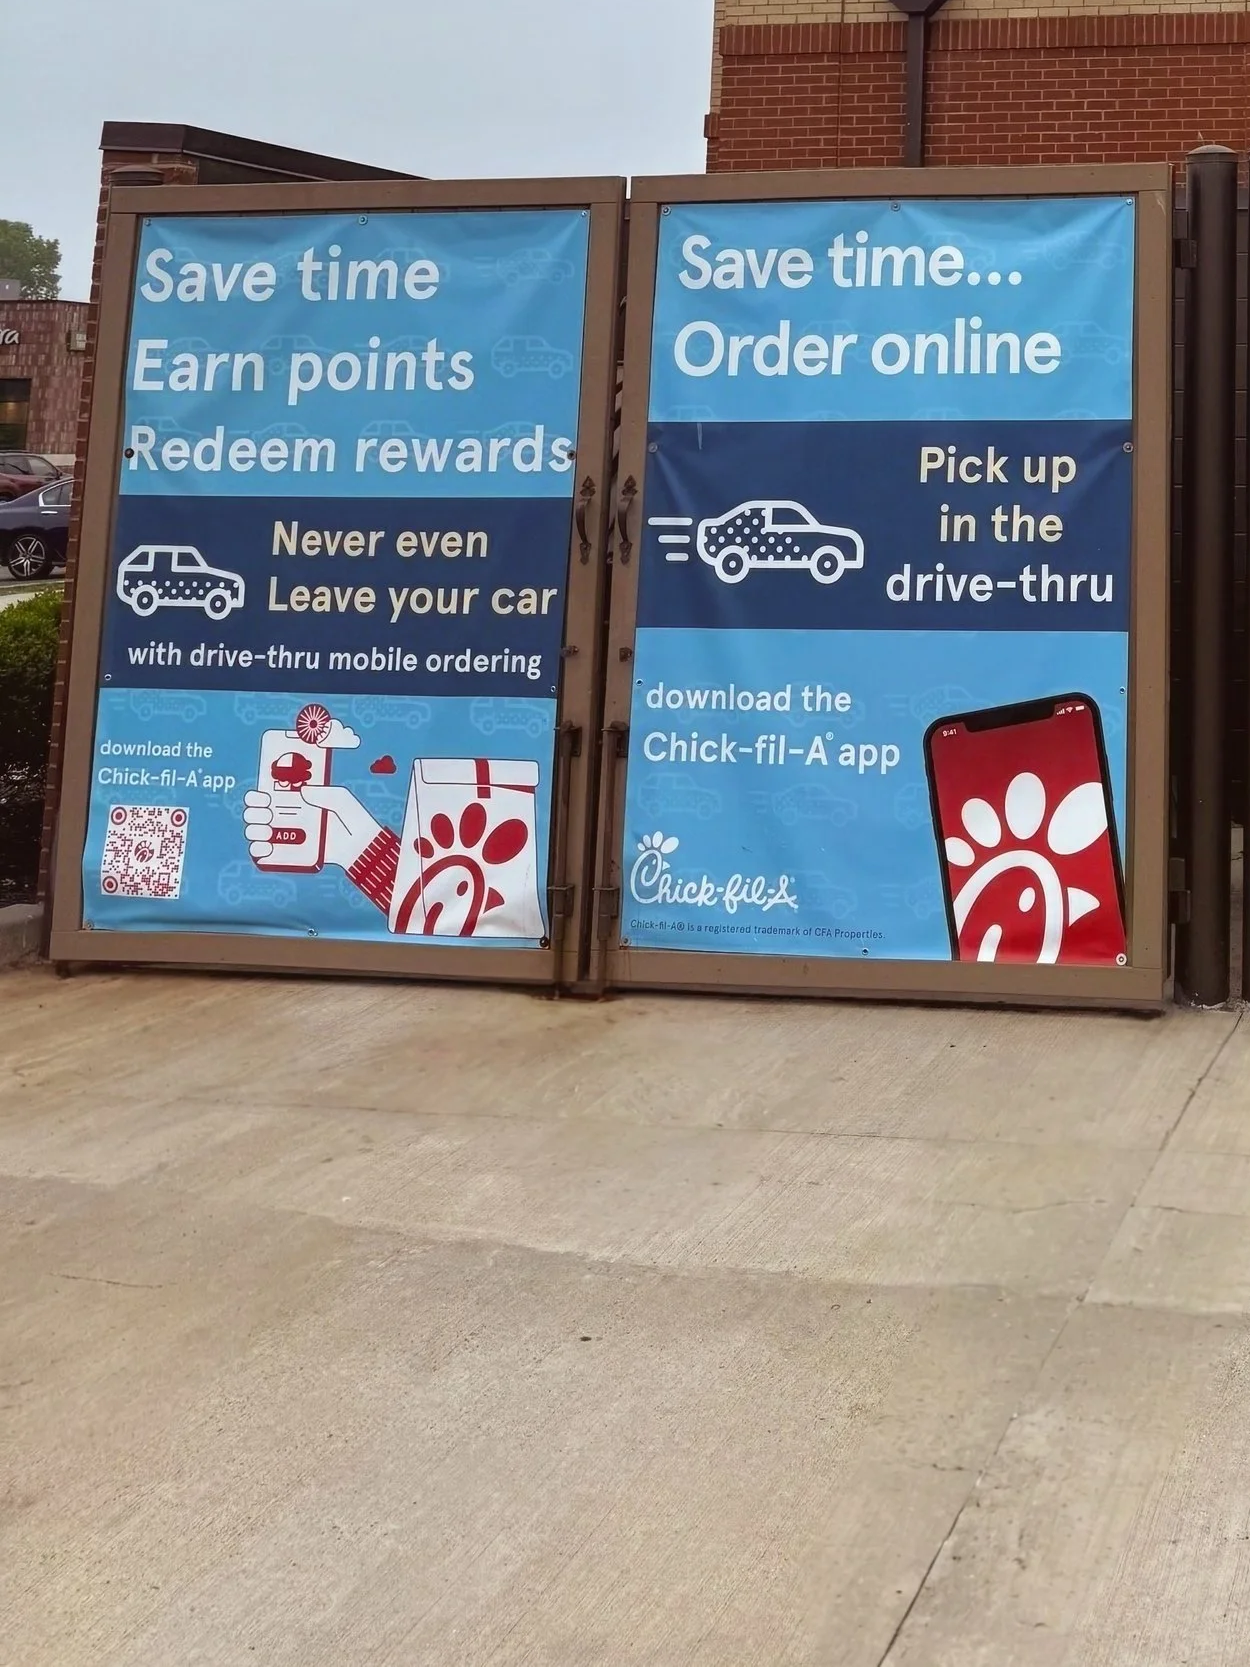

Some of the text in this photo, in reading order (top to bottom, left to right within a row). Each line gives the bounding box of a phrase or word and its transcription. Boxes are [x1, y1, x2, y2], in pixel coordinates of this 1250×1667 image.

[140, 244, 440, 302] Save time
[678, 230, 1022, 290] Save time...
[673, 315, 1062, 377] Order online
[133, 335, 474, 406] Earn points
[128, 424, 573, 473] Redeem rewards
[920, 445, 1077, 493] Pick up
[272, 520, 488, 558] Never even
[940, 503, 1064, 543] in the
[268, 576, 558, 623] Leave your car
[886, 562, 1113, 602] drive-thru
[127, 641, 542, 680] with drive-thru mobile ordering
[646, 682, 851, 712] download the
[100, 739, 213, 758] download the
[942, 728, 957, 737] 9:41
[838, 743, 901, 775] app
[202, 774, 236, 792] app
[276, 831, 297, 840] ADD
[687, 922, 695, 931] is
[705, 923, 751, 935] registered
[754, 925, 800, 936] trademark
[803, 927, 812, 936] of
[814, 928, 832, 938] CFA
[834, 929, 886, 940] Properties.
